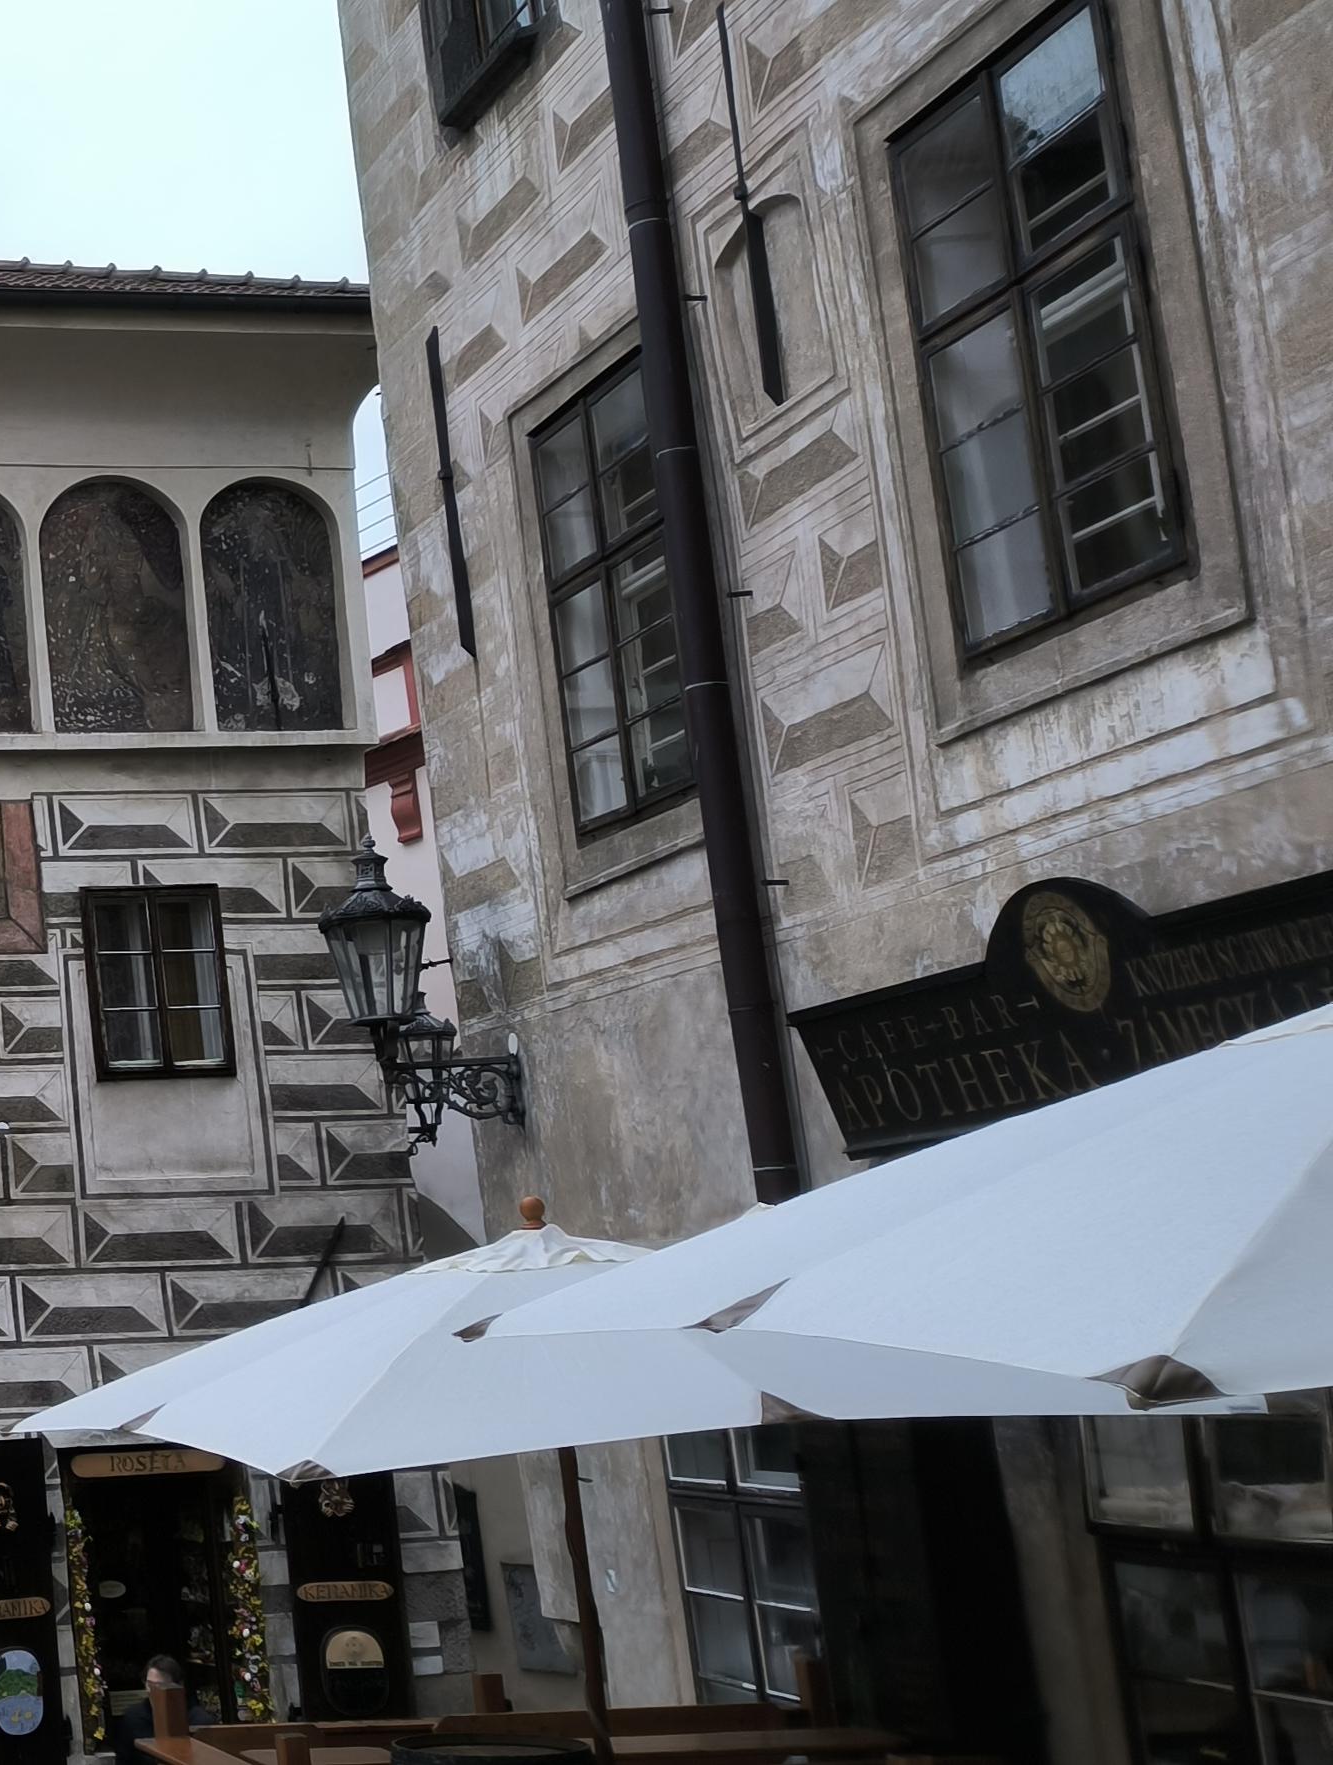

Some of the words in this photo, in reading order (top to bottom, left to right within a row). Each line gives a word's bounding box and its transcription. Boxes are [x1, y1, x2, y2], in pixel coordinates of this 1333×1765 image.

[836, 1029, 1100, 1131] APOTHEKA
[110, 1451, 187, 1473] ROSETA
[303, 1583, 390, 1600] KERAMIKA
